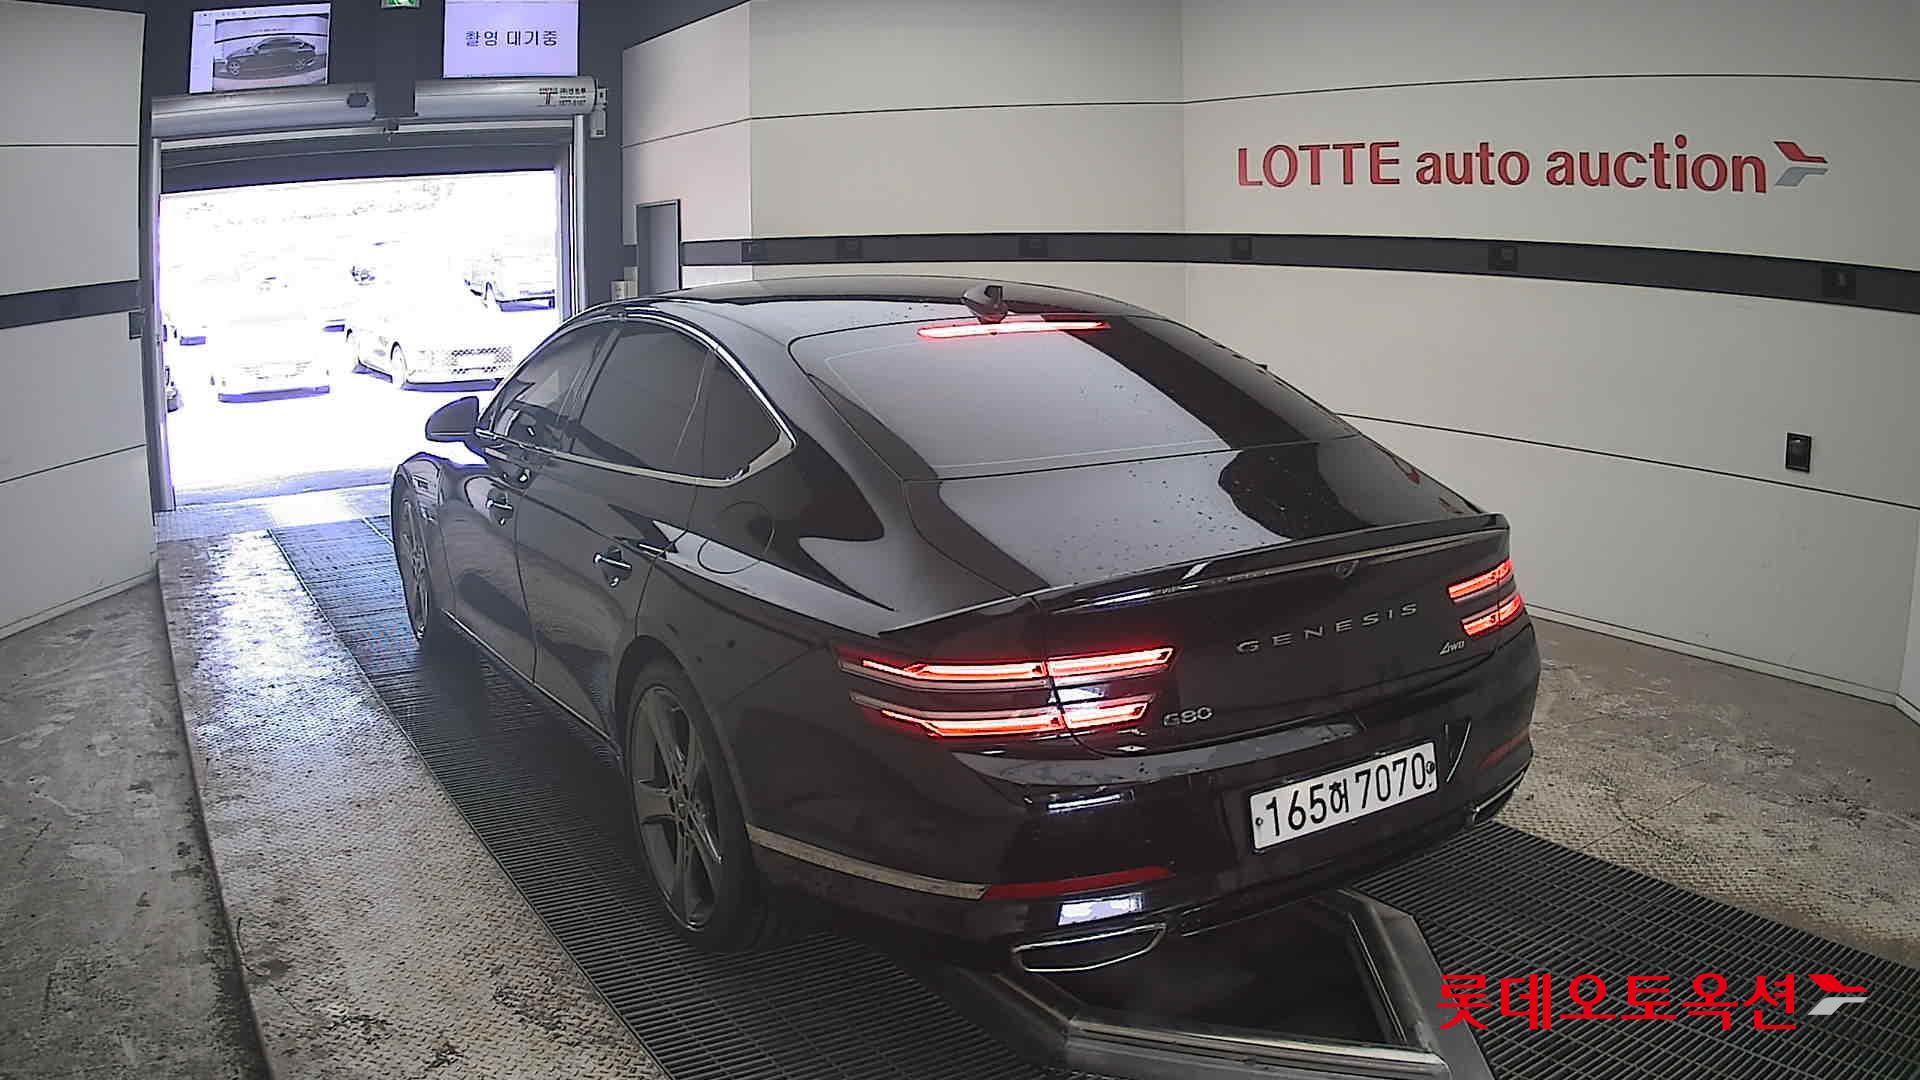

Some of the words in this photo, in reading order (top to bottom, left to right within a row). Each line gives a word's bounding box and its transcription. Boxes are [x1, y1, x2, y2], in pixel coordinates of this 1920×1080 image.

[1238, 141, 1401, 187] LOTTE
[1415, 141, 1531, 187] auto
[1545, 134, 1768, 194] auction
[1235, 602, 1418, 654] GENESIS
[1162, 705, 1214, 728] G80
